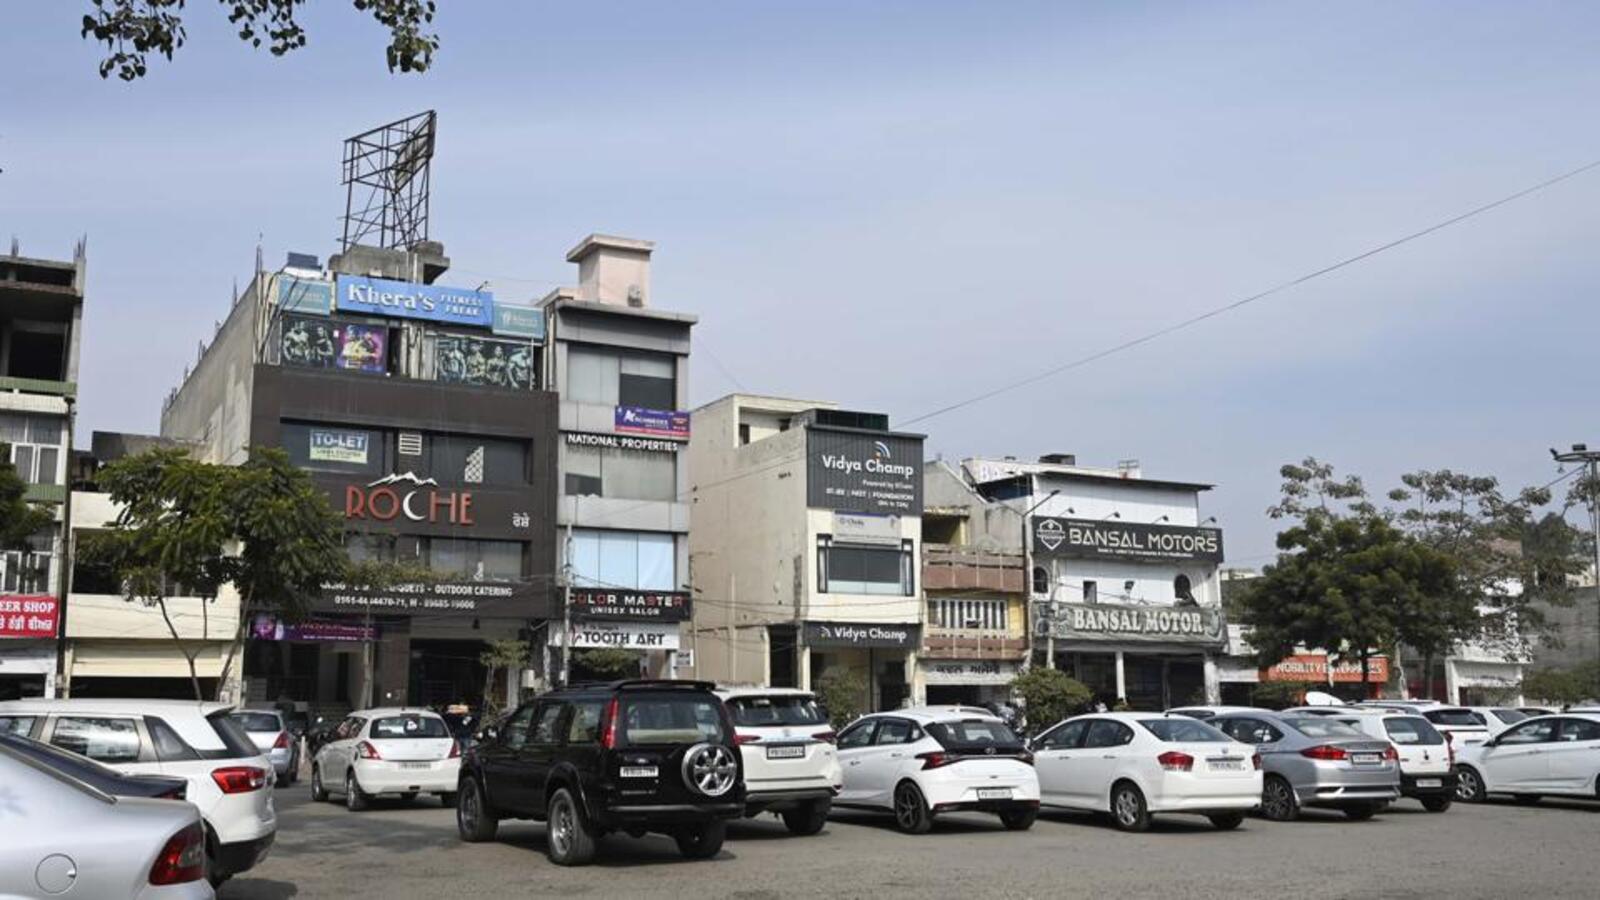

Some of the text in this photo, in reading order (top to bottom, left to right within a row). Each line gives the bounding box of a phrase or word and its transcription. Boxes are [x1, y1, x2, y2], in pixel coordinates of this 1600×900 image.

[348, 284, 435, 312] Khera's
[313, 433, 364, 449] TO-LET
[567, 434, 678, 451] NATIONAL PROPERTIES
[822, 454, 914, 480] Vidya Champ
[346, 485, 475, 526] ROCHE
[1069, 528, 1143, 549] BANSAL
[1149, 532, 1217, 553] MOTORS
[434, 584, 473, 596] OUTDOOR
[474, 586, 513, 598] CATERING
[23, 601, 55, 613] SHOP
[1074, 608, 1204, 633] BANSAL MOTOR
[582, 630, 665, 646] TOOTH ART
[834, 626, 907, 644] Vidya Champ
